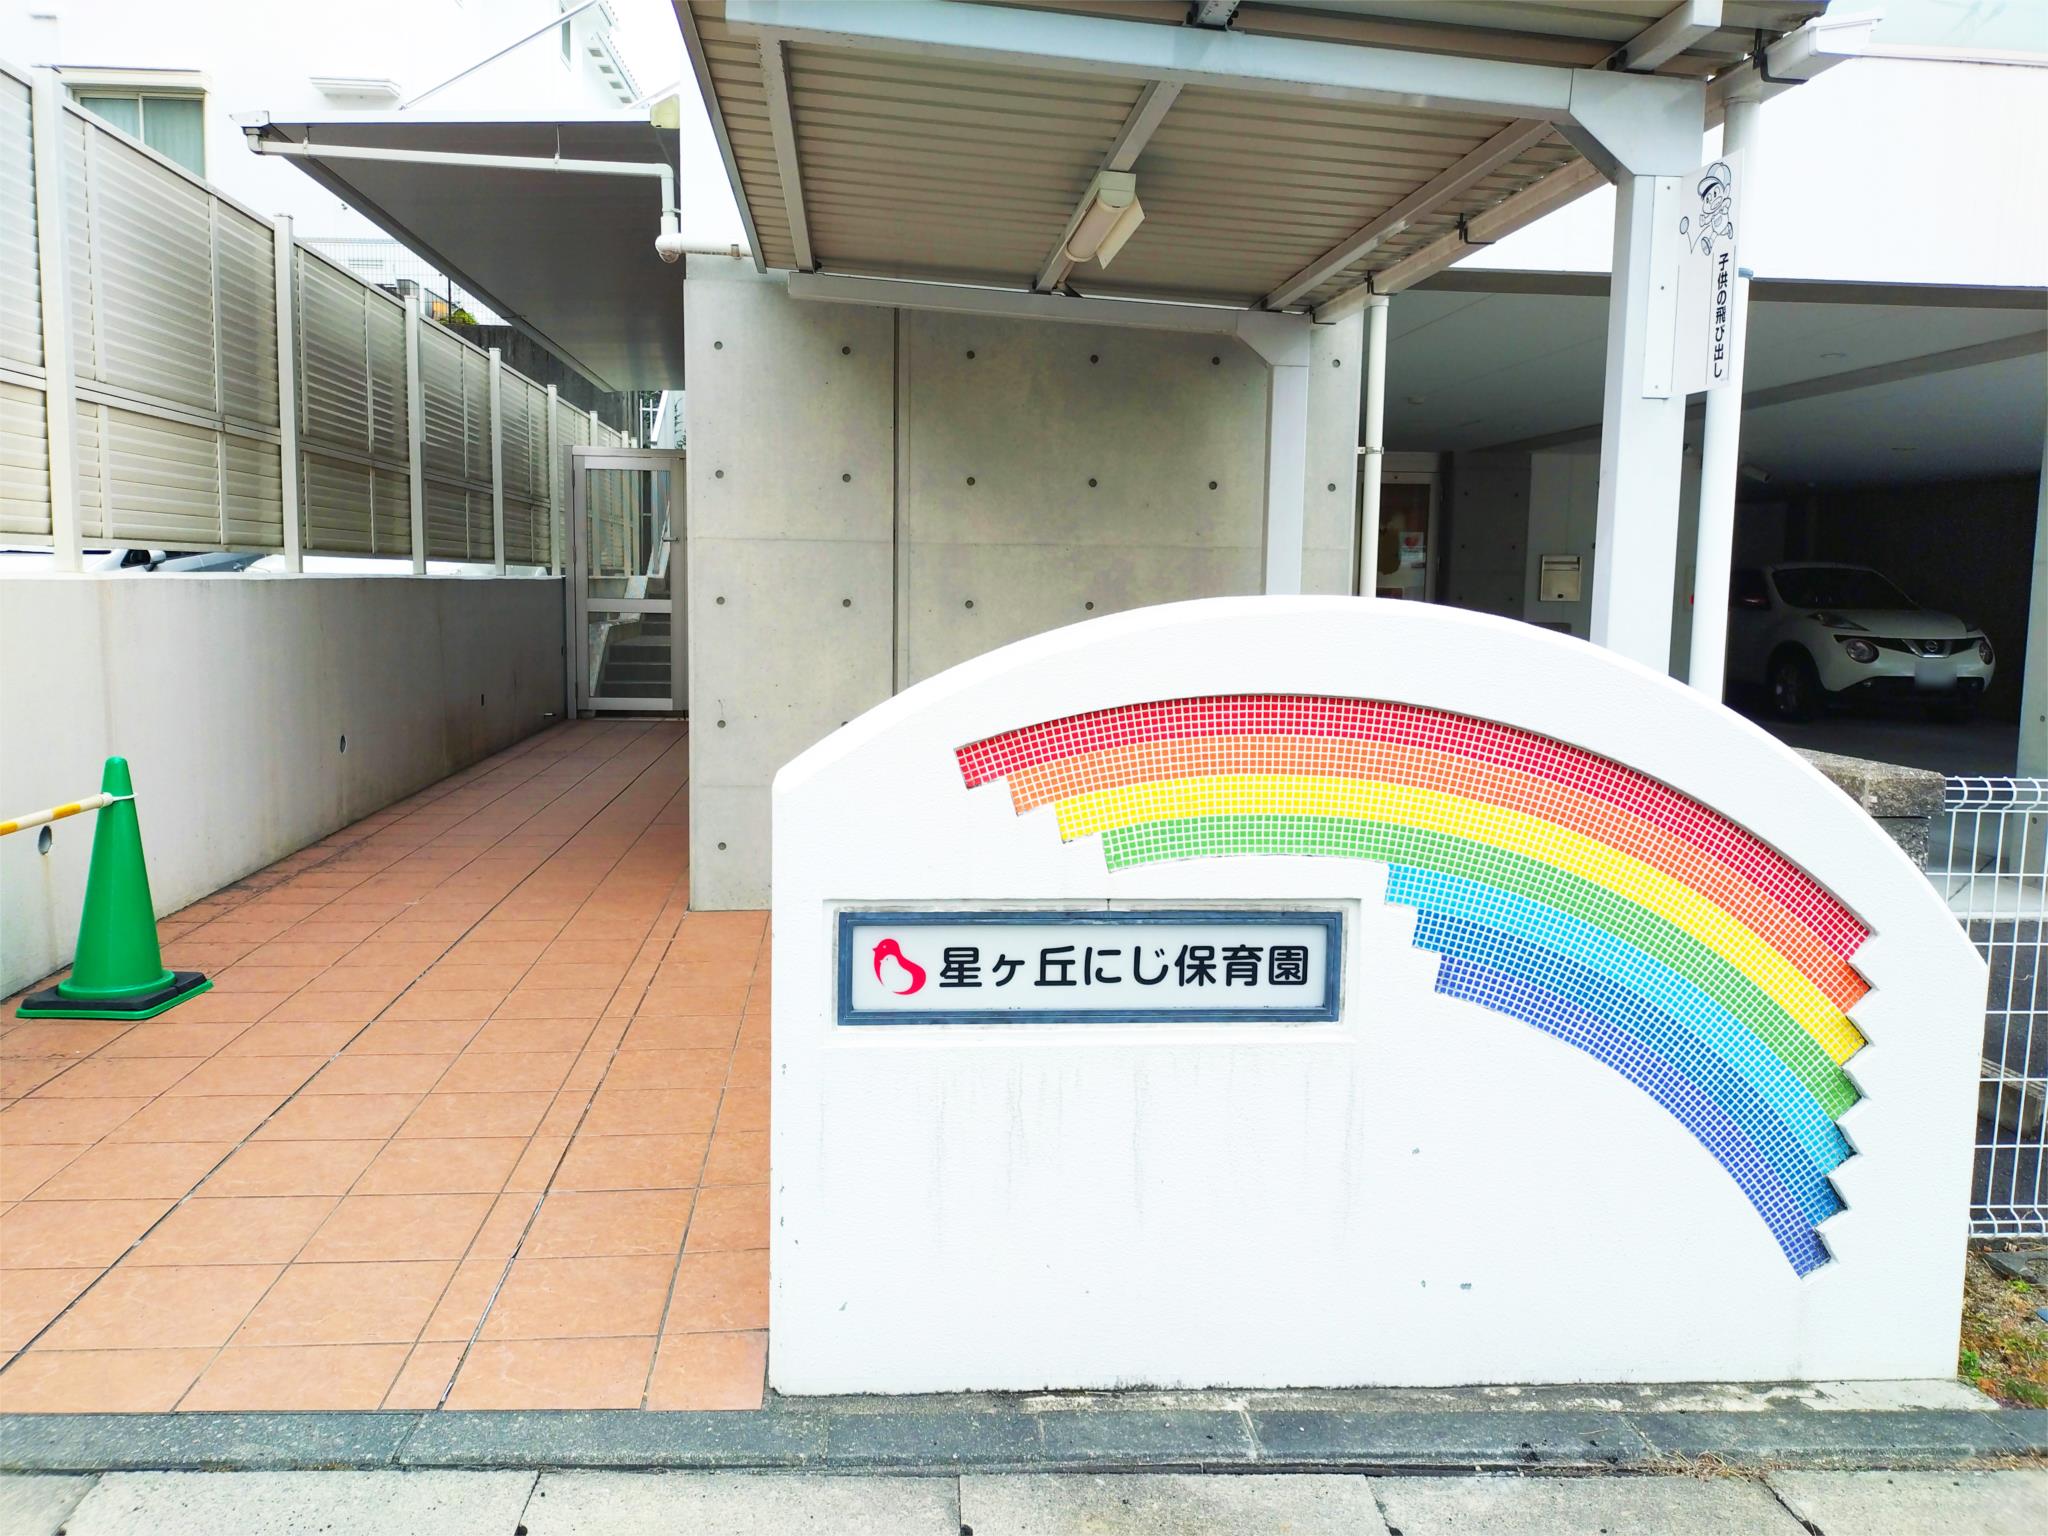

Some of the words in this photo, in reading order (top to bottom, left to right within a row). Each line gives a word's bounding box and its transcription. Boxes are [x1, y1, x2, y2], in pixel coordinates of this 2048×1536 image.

[1713, 252, 1729, 378] 子供の飛び出し
